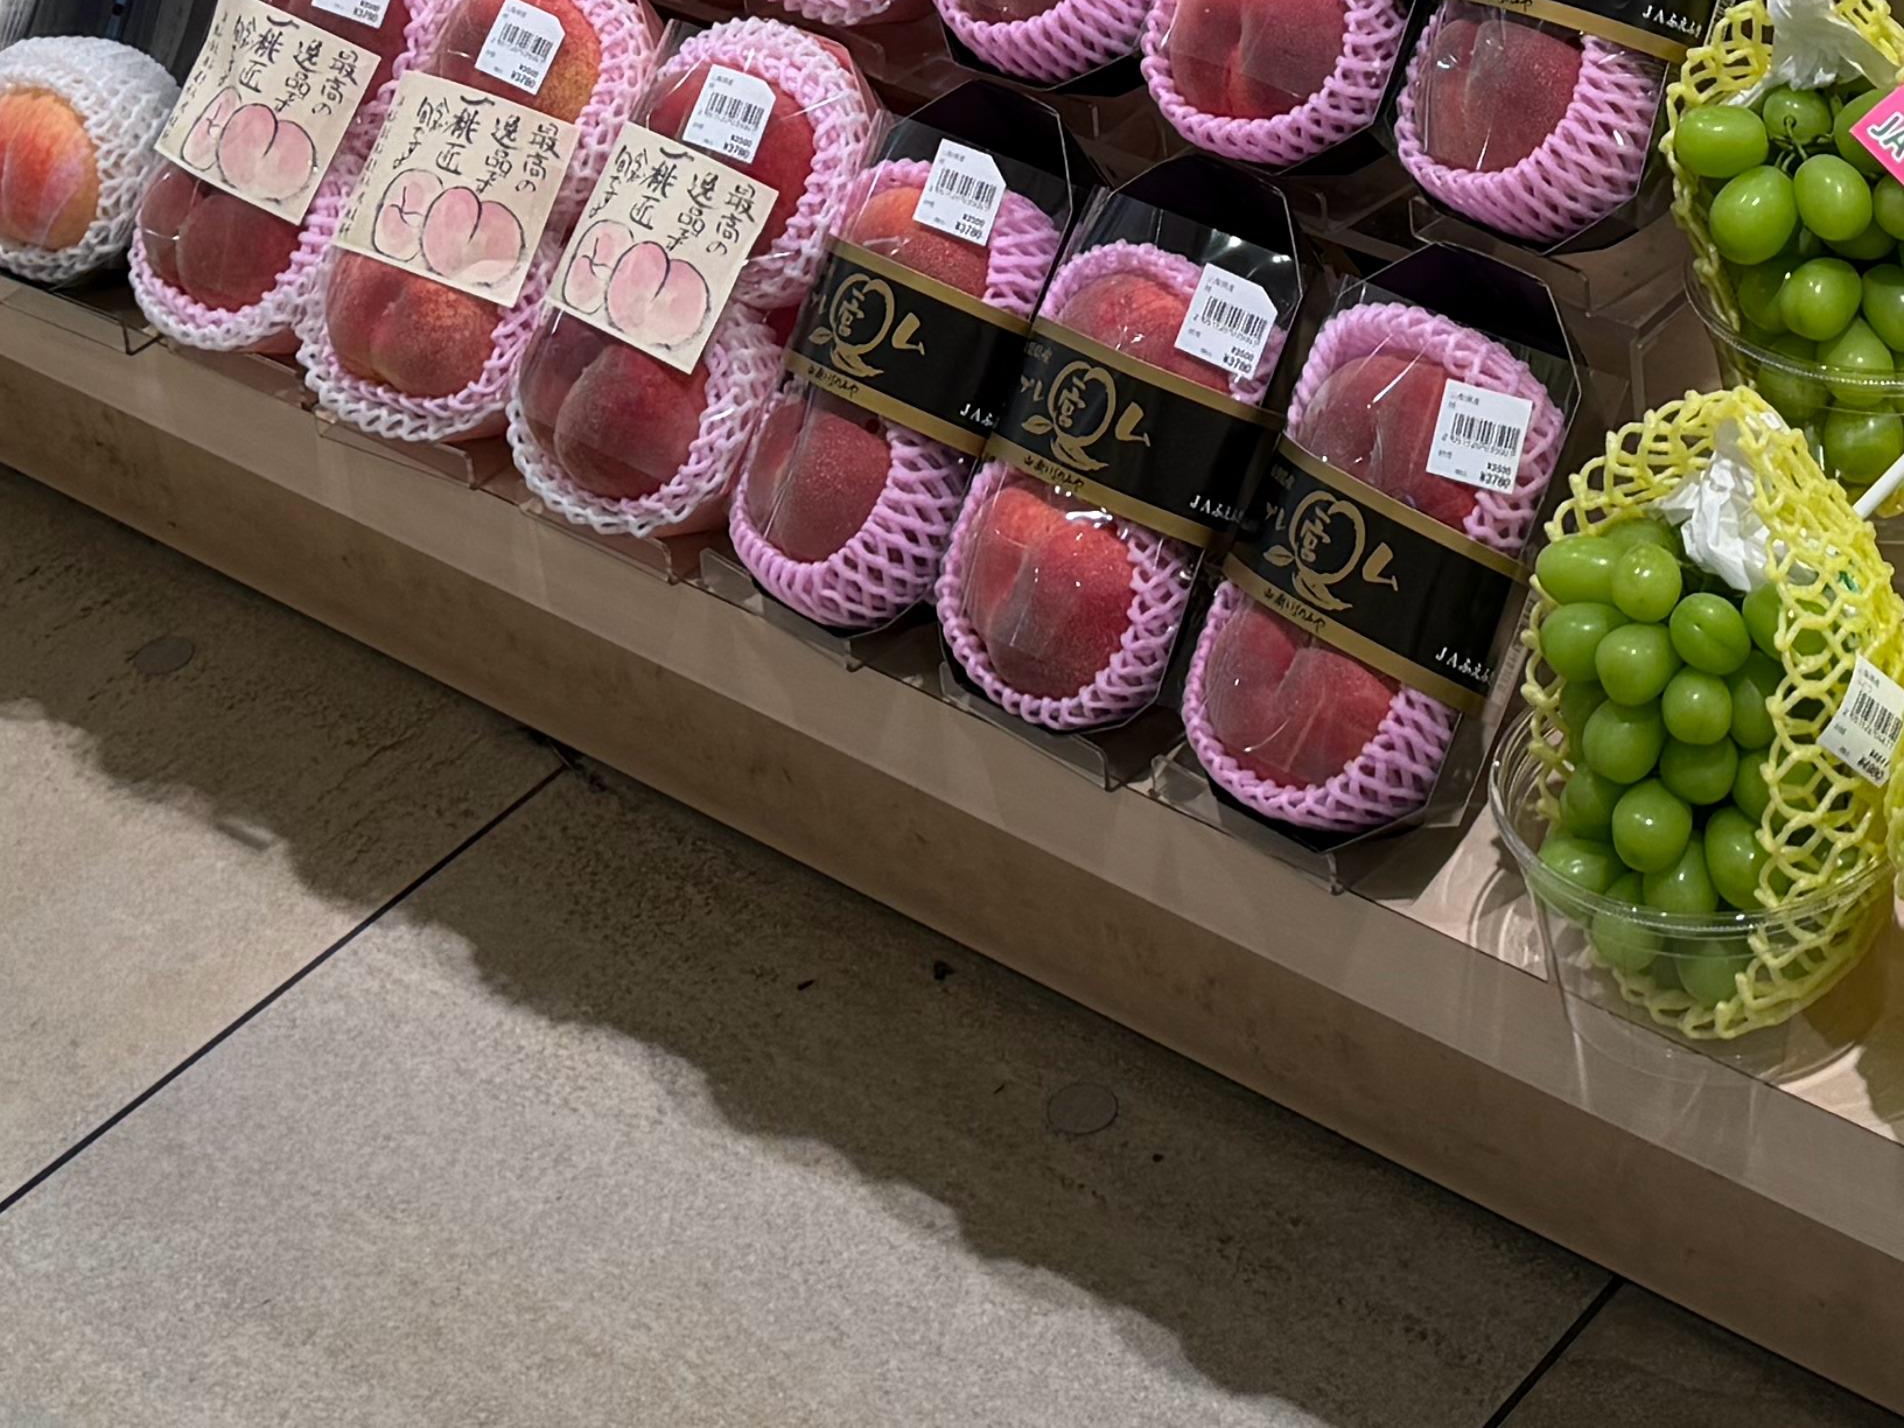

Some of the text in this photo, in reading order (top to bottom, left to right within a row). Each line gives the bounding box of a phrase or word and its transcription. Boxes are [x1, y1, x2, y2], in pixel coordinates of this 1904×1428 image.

[515, 123, 561, 193] 最高の
[1479, 471, 1511, 490] ¥3780
